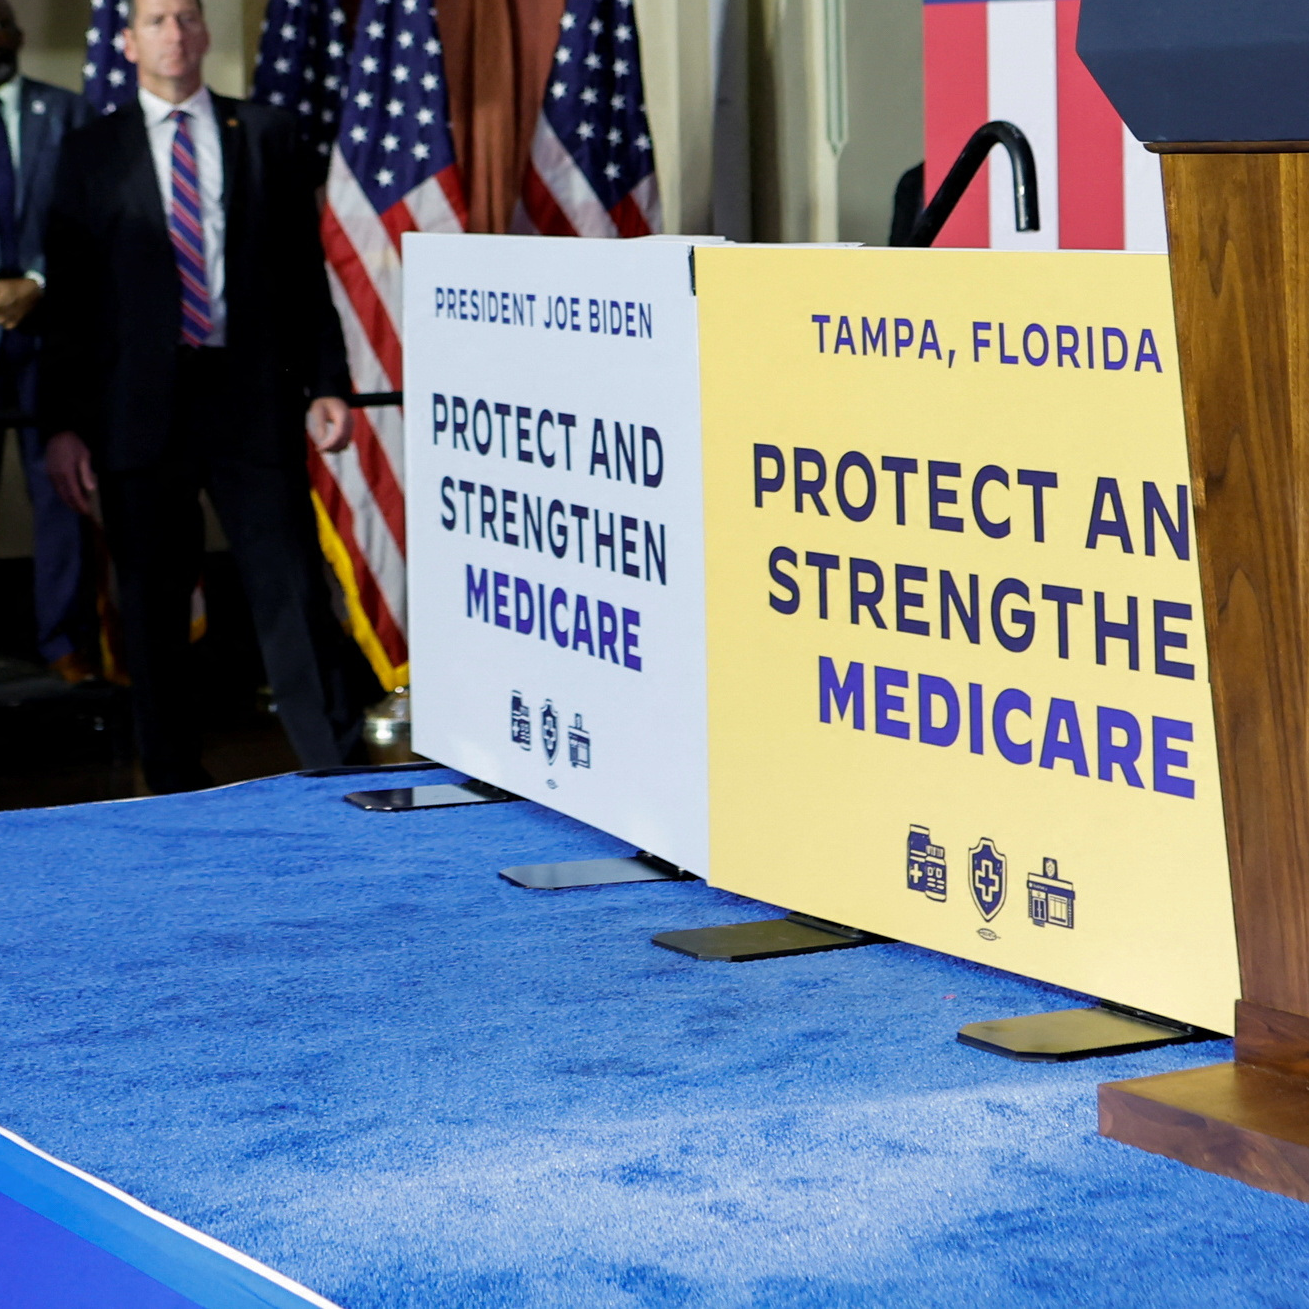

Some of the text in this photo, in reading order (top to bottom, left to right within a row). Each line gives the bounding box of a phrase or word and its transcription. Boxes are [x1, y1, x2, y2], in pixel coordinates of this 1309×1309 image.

[435, 287, 652, 339] PRESIDENT JOE BIDEN
[811, 314, 1163, 374] TAMPA, FLORIDA
[432, 392, 664, 489] PROTECT AND
[440, 475, 668, 586] STRENGTHEN
[753, 442, 1191, 562] PROTECT AN
[465, 564, 643, 673] MEDICARE
[768, 546, 1196, 682] STRENGTHE
[817, 655, 1196, 800] MEDICARE
